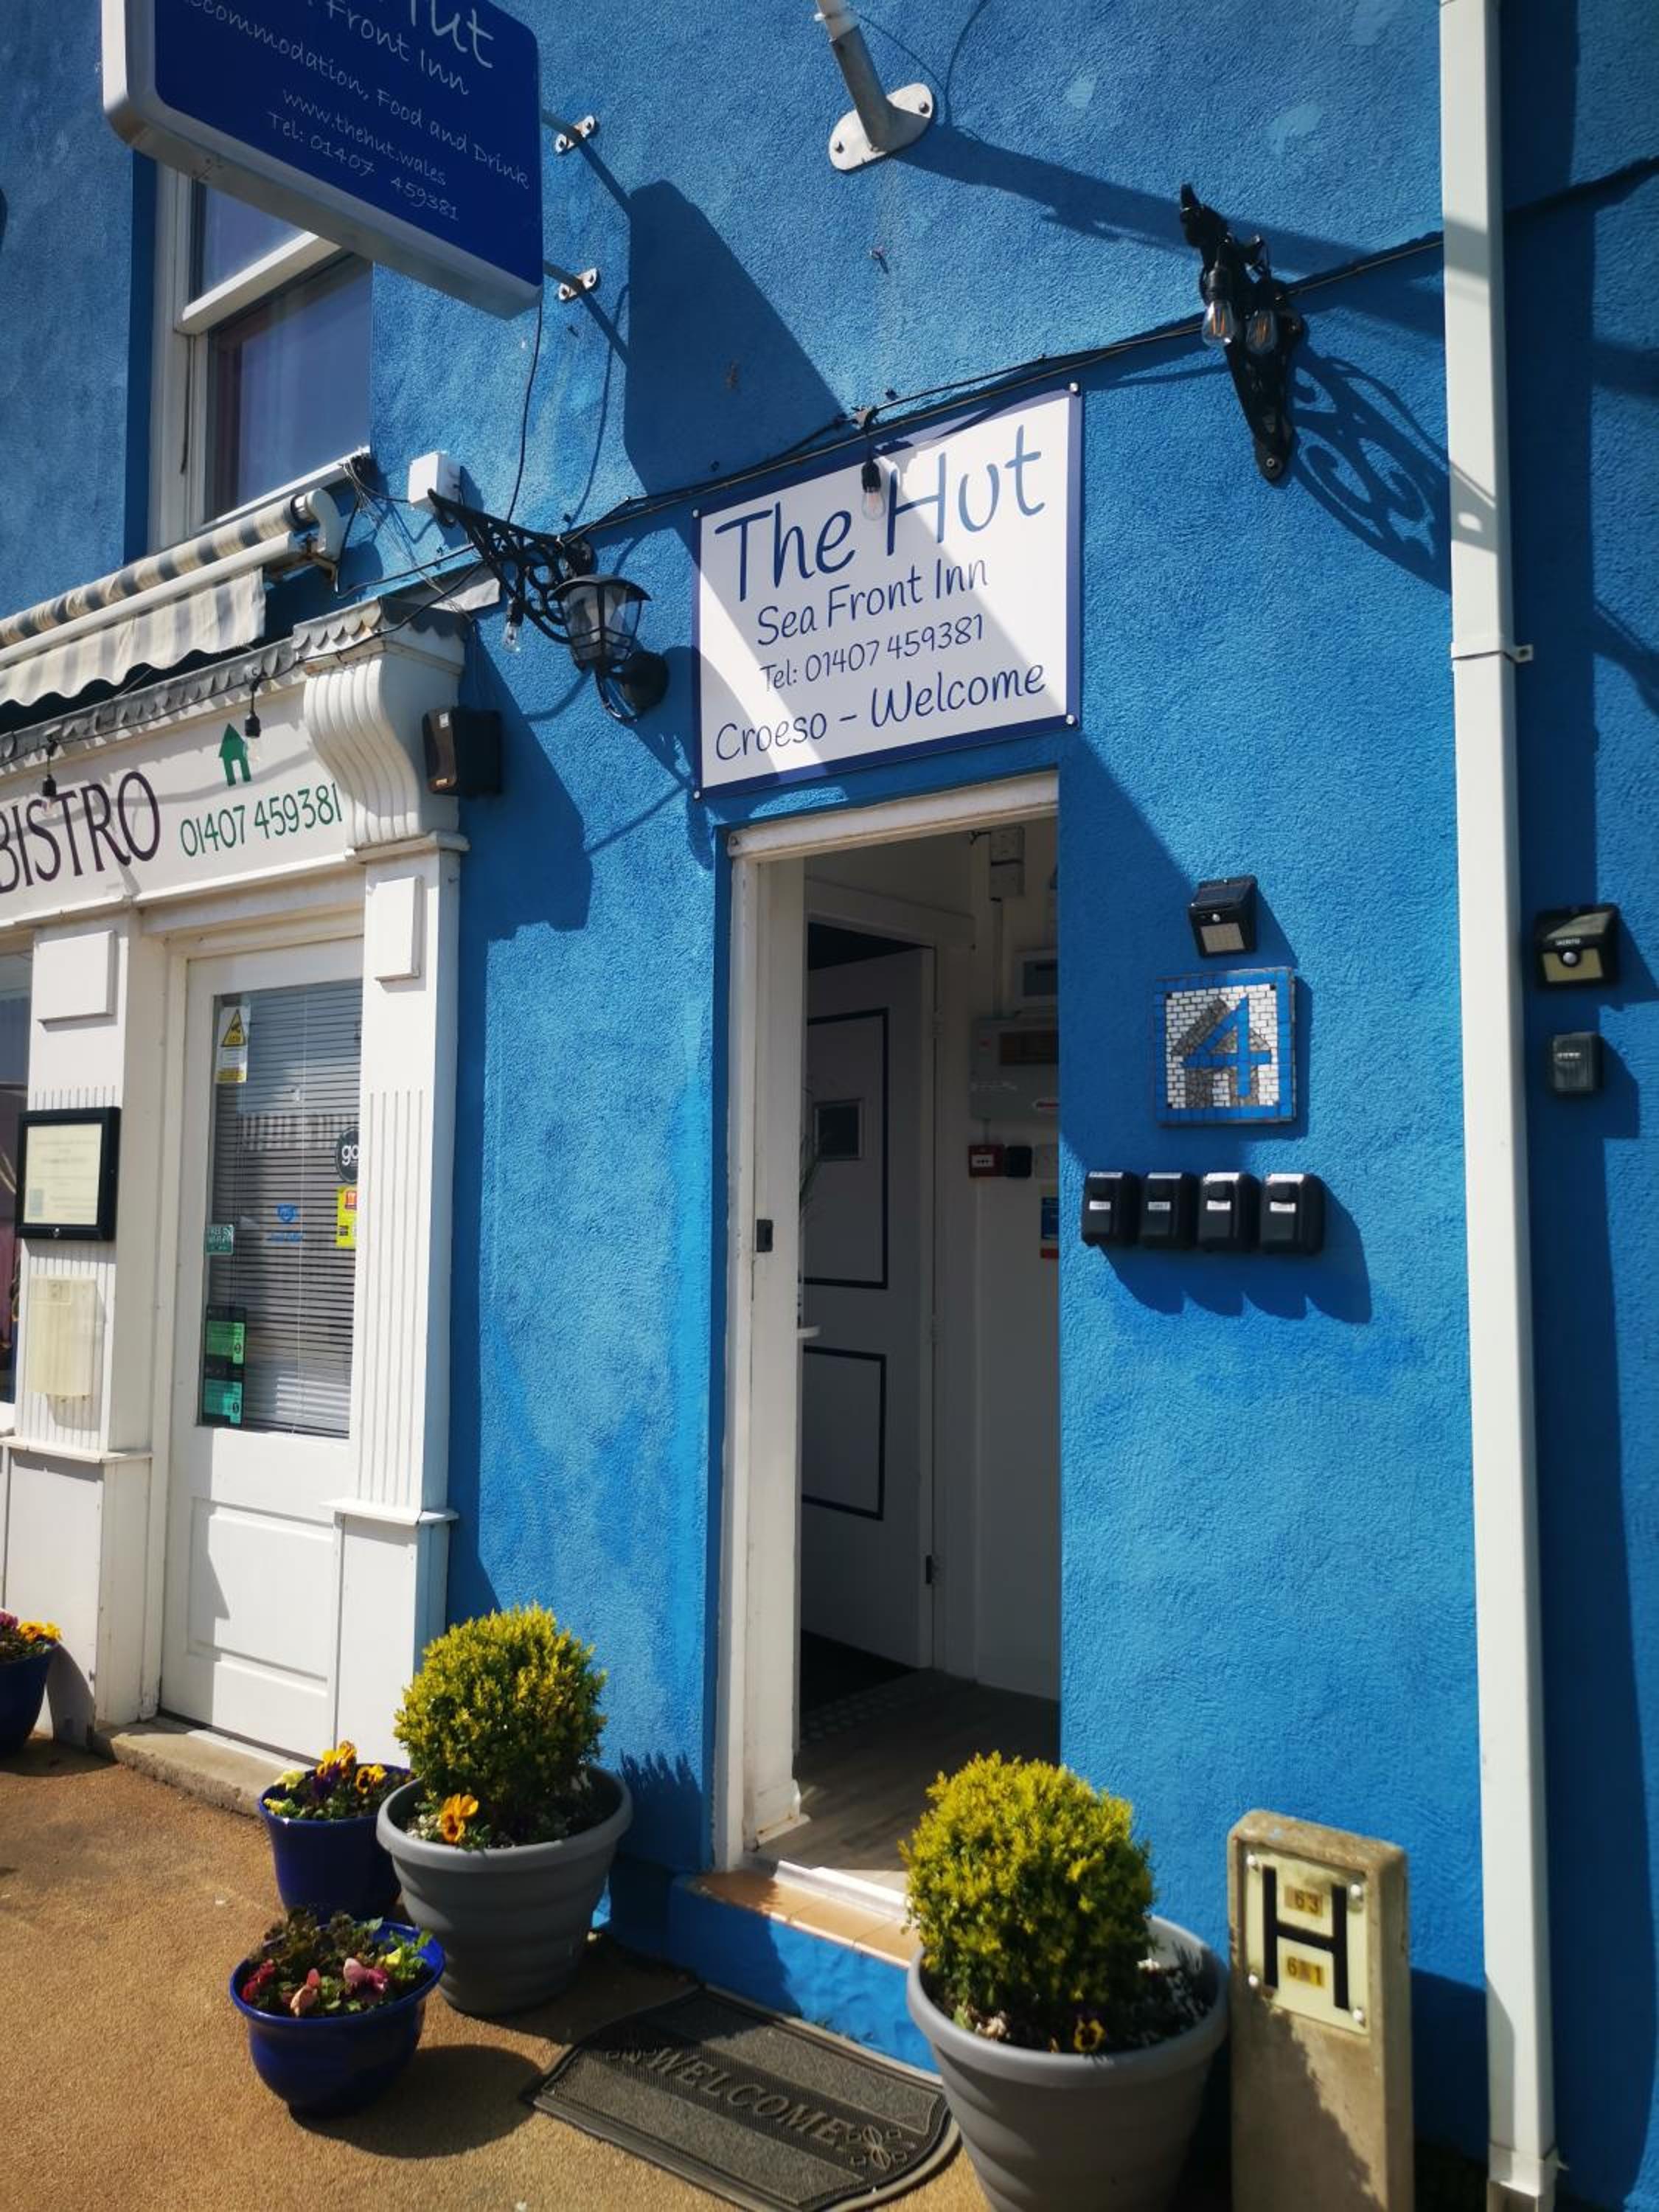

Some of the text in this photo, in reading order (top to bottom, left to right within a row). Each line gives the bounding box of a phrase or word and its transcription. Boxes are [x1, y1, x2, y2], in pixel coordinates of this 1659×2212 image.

[327, 0, 469, 95] Front Inn
[267, 111, 459, 220] Tel: 01407 459381
[283, 89, 447, 186] www.thehut.wales
[377, 88, 422, 128] Food
[431, 120, 467, 153] and
[473, 144, 529, 190] Drink
[714, 425, 1045, 601] The Hut
[757, 558, 988, 645] Sea Front Inn
[760, 613, 983, 692] Tel: 01407 459381
[716, 712, 827, 761] Croeso
[872, 664, 1046, 728] Welcome
[180, 782, 342, 857] 01407 459381
[1185, 997, 1272, 1096] 4
[1263, 1866, 1349, 2010] H
[650, 2047, 851, 2145] WELCOME
